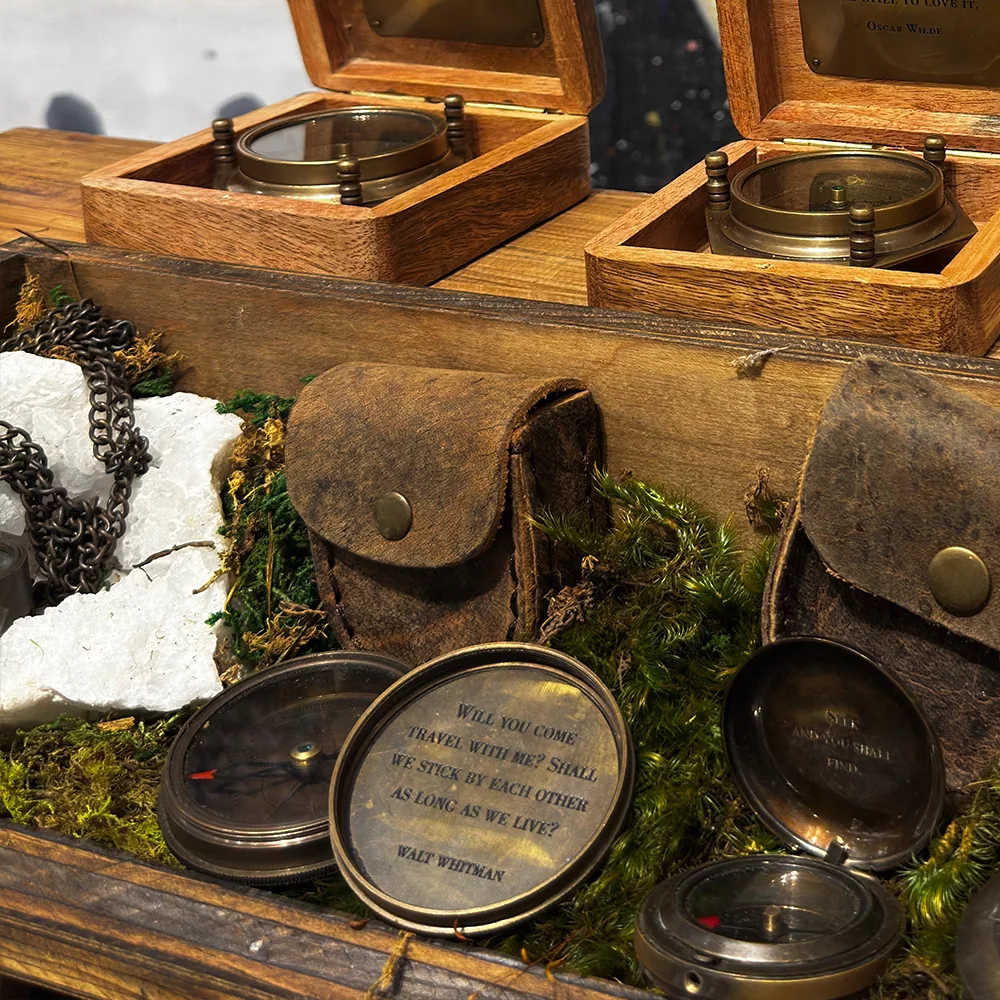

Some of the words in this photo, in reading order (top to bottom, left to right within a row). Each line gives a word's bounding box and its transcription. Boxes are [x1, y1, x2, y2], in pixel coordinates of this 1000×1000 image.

[962, 0, 978, 9] IT.
[408, 725, 463, 749] TRAVEL
[469, 741, 509, 760] WITH
[511, 752, 545, 768] ME?
[500, 715, 532, 733] YOU
[533, 725, 578, 745] COME
[392, 753, 416, 768] WE
[417, 760, 461, 781] STICK
[464, 772, 485, 787] BY
[489, 777, 537, 798] EACH
[535, 789, 589, 812] OTHER
[390, 786, 412, 800] AS
[414, 791, 458, 812] LONG
[460, 803, 481, 817] AS
[485, 809, 510, 825] WE
[512, 816, 560, 838] LIVE?
[397, 845, 435, 864] WALT
[437, 856, 505, 882] WHITMAN
